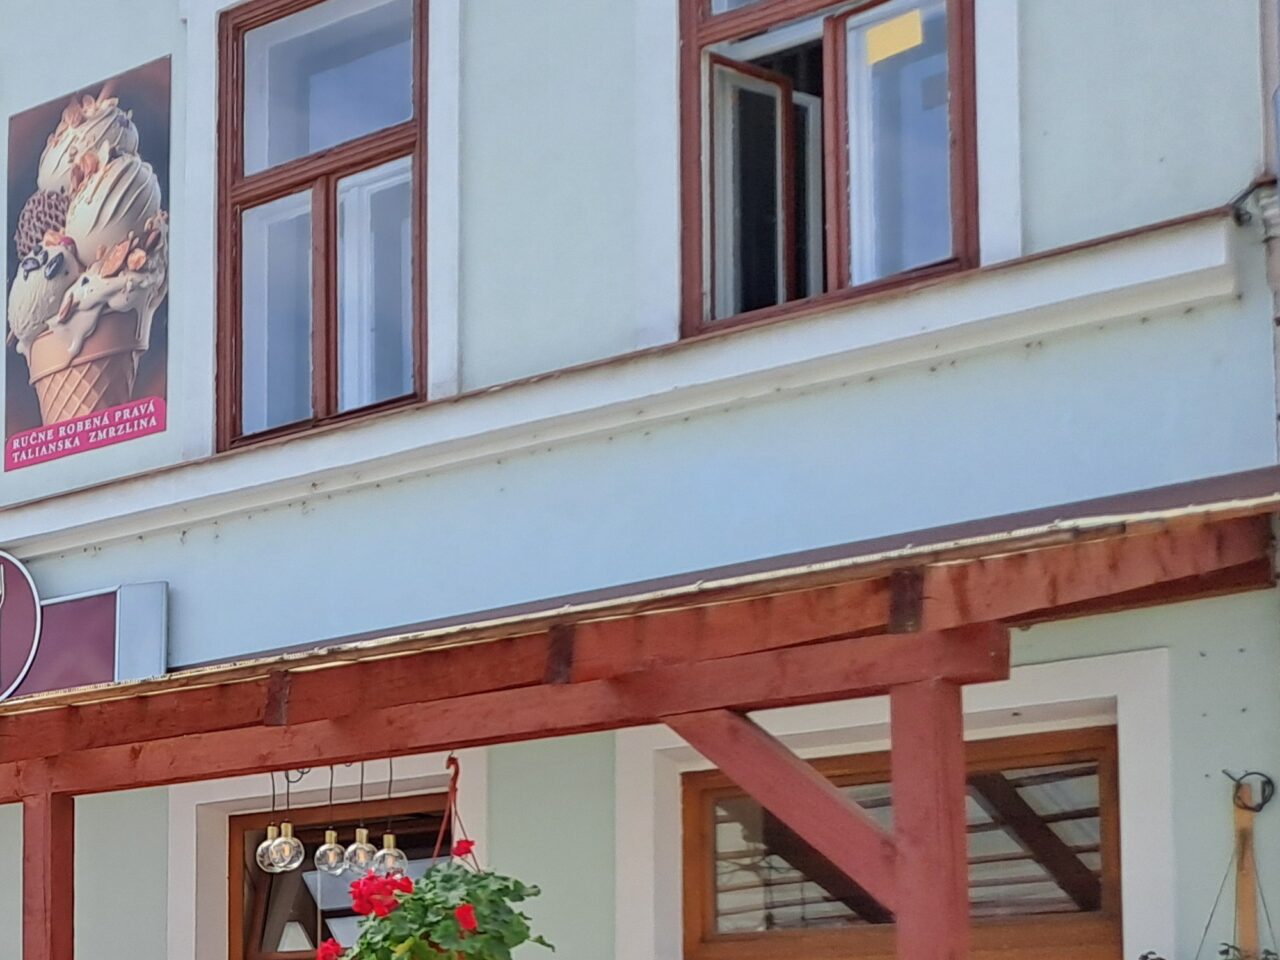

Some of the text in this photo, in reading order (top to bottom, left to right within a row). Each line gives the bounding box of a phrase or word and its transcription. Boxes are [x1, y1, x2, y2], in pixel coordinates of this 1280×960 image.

[12, 399, 156, 450] RUČNE ROBENÁ PRAVÁ
[12, 416, 158, 463] TALIANSKA ZMRZLINA
